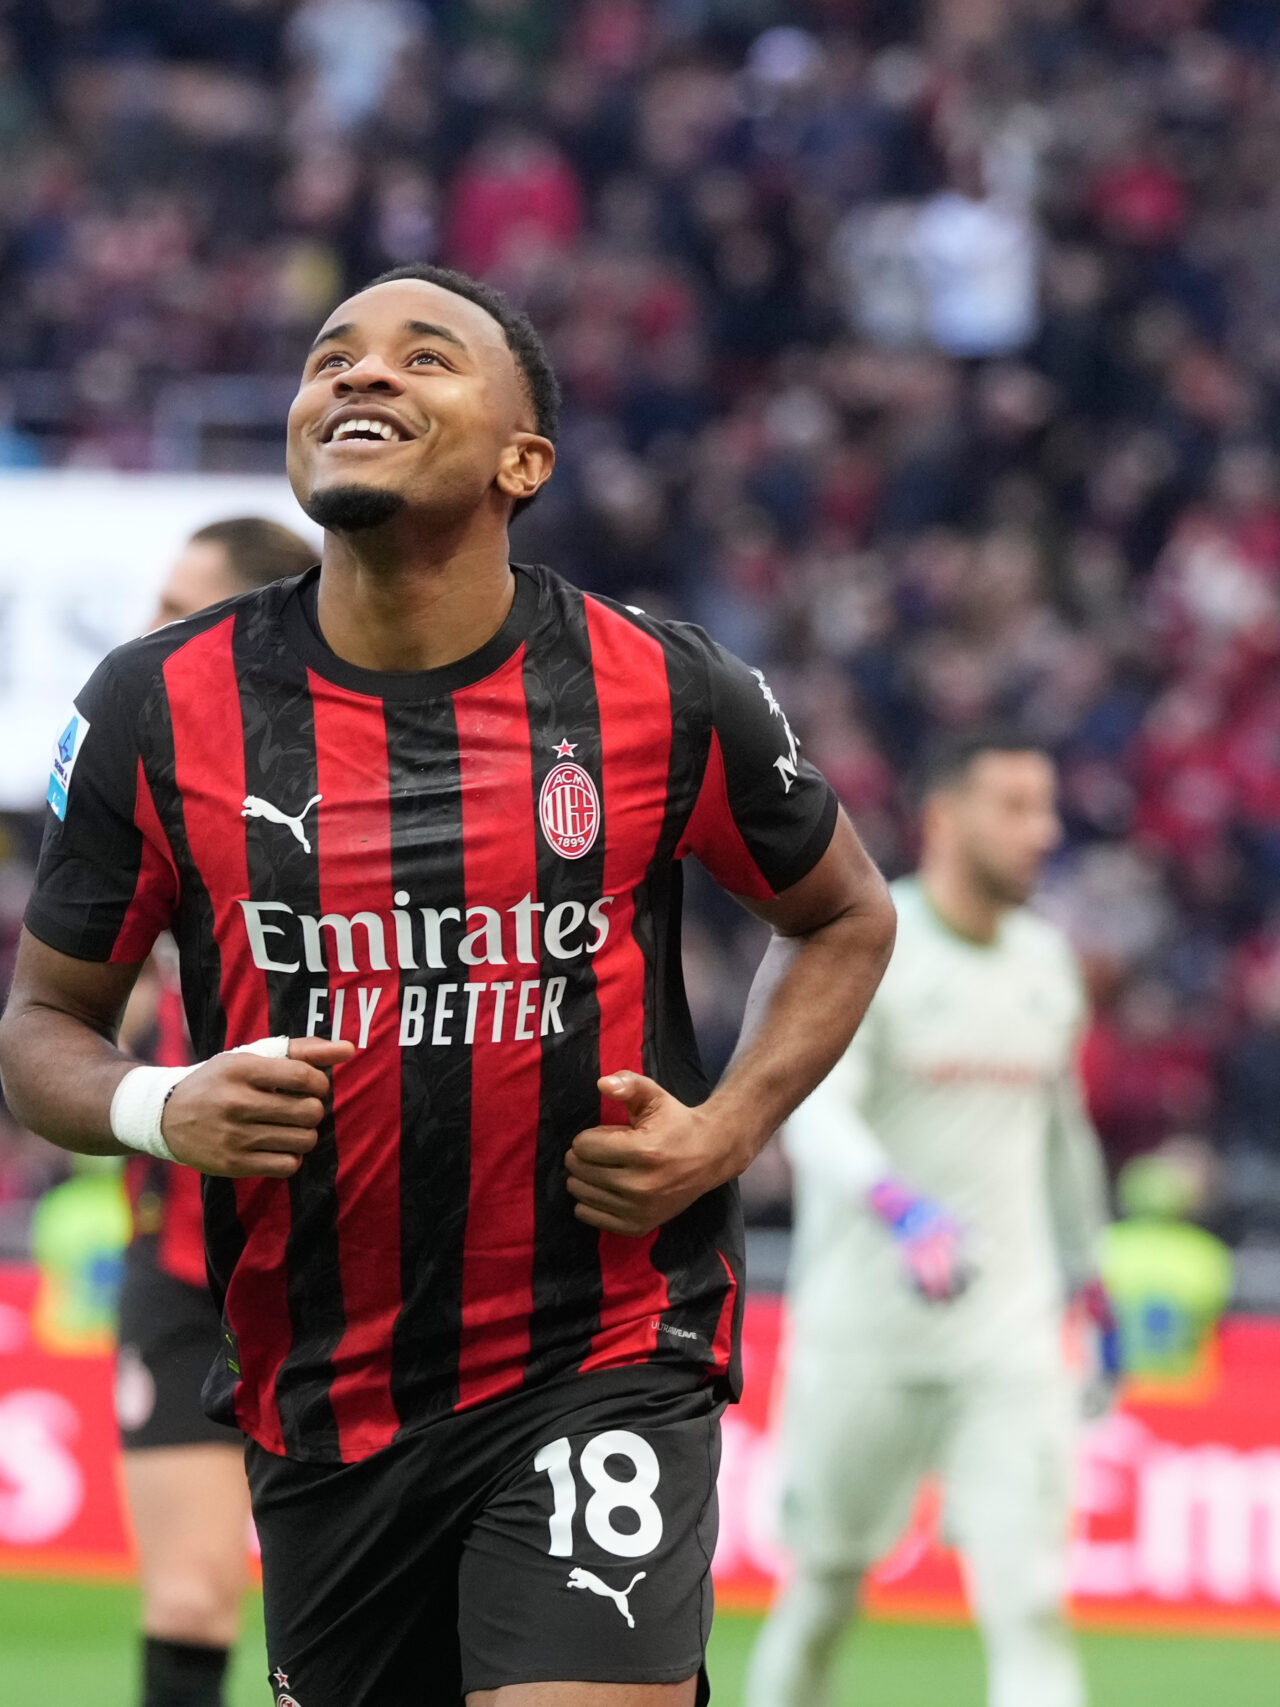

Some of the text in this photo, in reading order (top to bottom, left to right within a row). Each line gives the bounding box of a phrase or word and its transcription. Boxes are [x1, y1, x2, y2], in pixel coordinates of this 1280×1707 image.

[552, 771, 584, 788] ACM
[557, 836, 585, 848] 1899
[237, 890, 614, 974] Emirates
[398, 976, 567, 1047] BETTER
[651, 1320, 697, 1340] ULTRAWEAVE
[534, 1429, 663, 1558] 18
